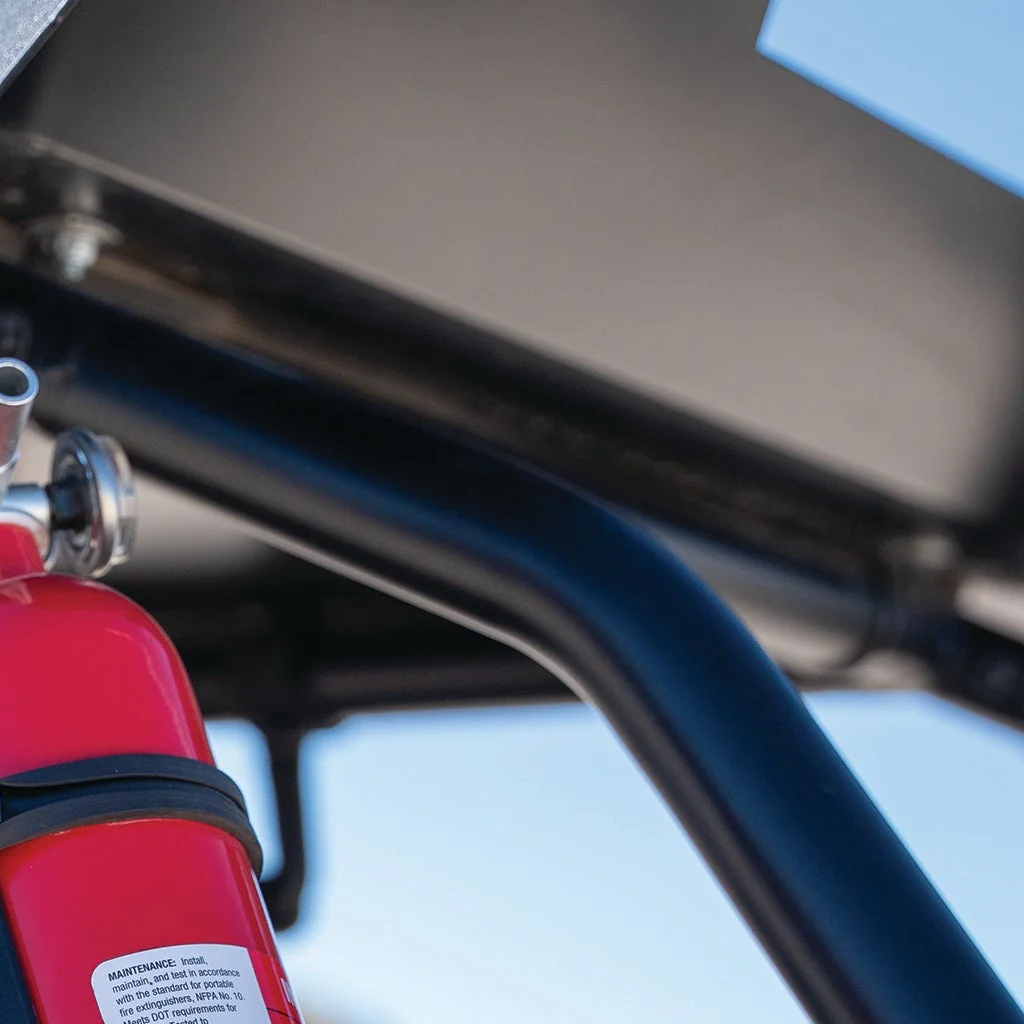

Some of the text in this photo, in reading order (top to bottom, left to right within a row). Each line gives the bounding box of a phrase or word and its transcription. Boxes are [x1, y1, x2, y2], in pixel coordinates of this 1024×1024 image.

[108, 959, 177, 982] MAINTENANCE:
[153, 972, 170, 984] and
[171, 970, 188, 980] test
[188, 969, 198, 978] in
[198, 969, 241, 978] accordance
[116, 980, 235, 1006] with the standard for portable
[120, 1008, 135, 1018] fire
[136, 995, 196, 1013] extinguishers,
[195, 992, 219, 1002] NFPA
[218, 992, 233, 1001] No.
[151, 1010, 170, 1022] DOT
[172, 1004, 226, 1018] requirements
[226, 1004, 237, 1012] for
